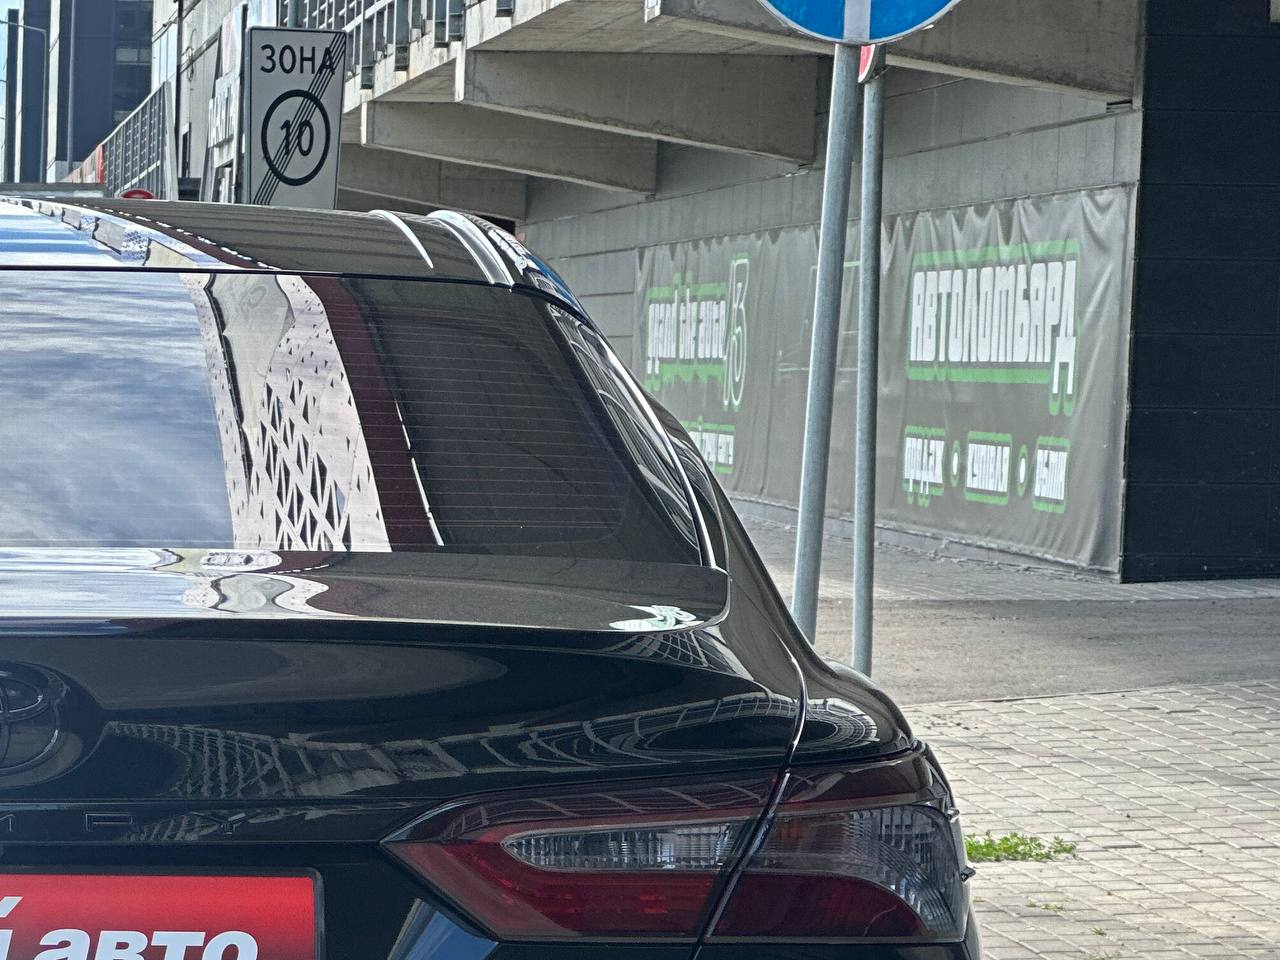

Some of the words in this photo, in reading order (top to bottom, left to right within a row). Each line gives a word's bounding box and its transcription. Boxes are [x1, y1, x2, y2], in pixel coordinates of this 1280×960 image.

[260, 44, 335, 75] ЗОНА
[280, 119, 314, 156] 10
[910, 260, 1076, 394] АВТОЛОМБАРД
